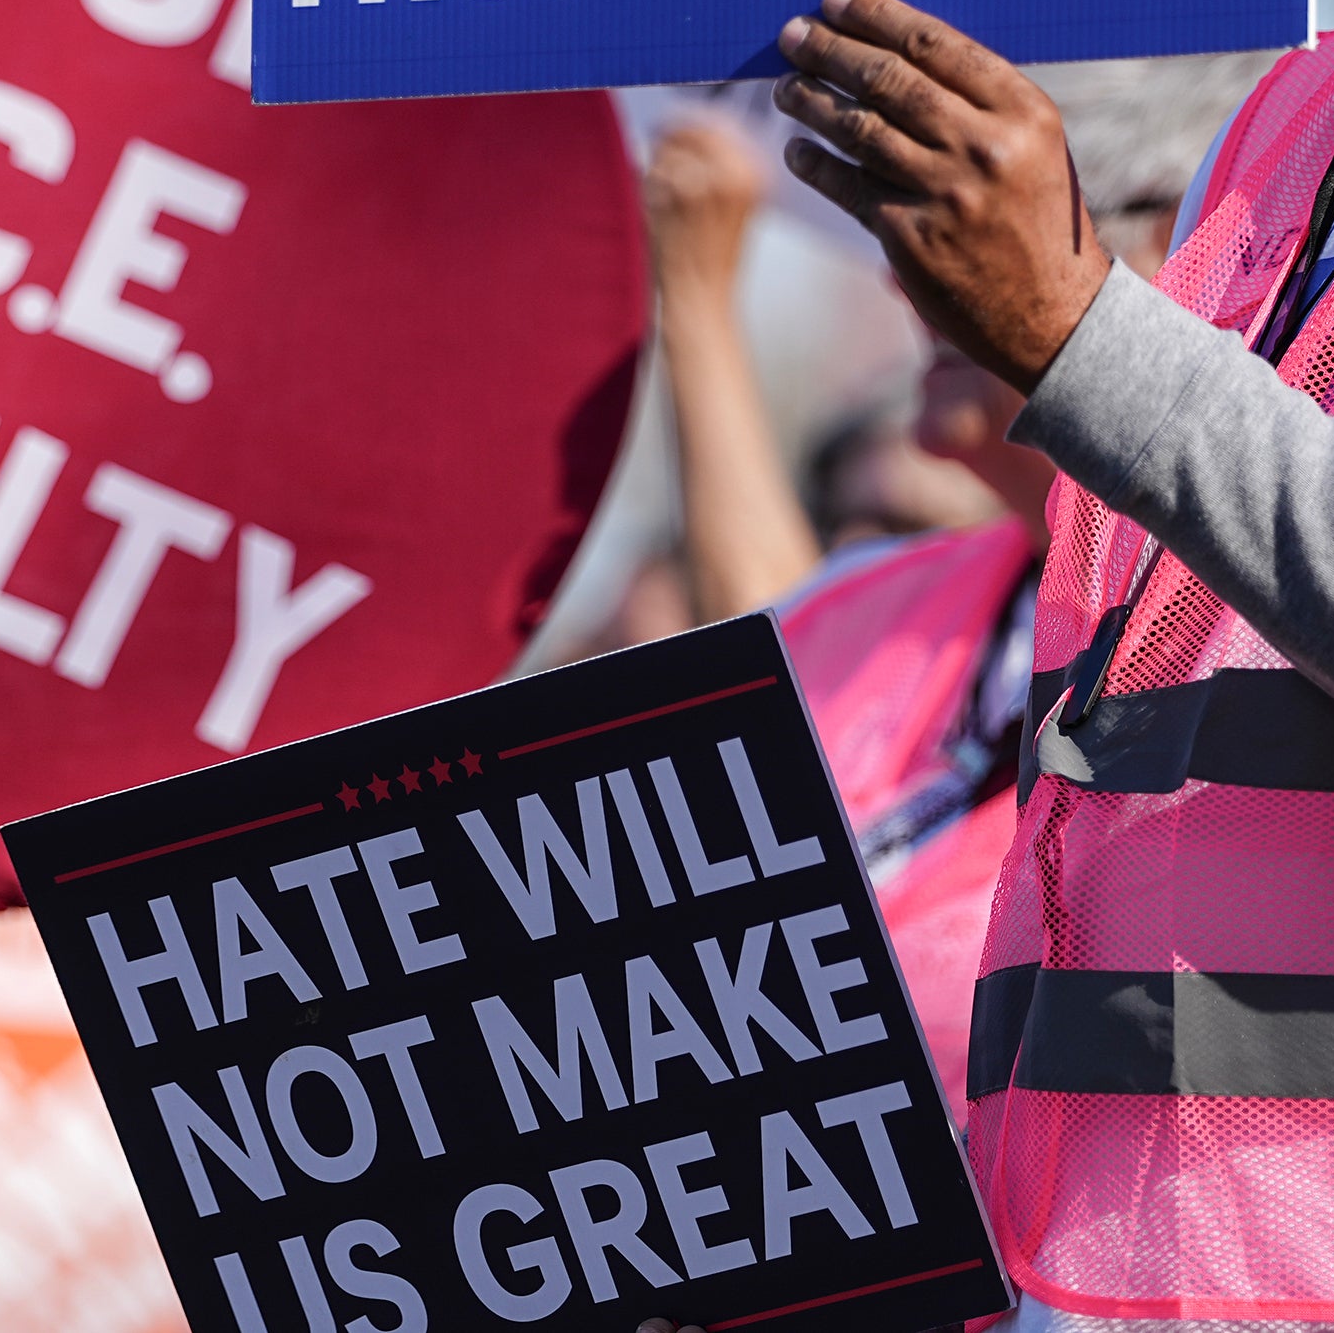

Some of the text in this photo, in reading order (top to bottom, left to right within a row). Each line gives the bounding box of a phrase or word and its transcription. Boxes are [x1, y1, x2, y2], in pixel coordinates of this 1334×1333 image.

[85, 736, 826, 1048] HATE WILL
[150, 1013, 447, 1218] NOT
[470, 903, 890, 1134] MAKE
[213, 1079, 919, 1333] US GREAT
